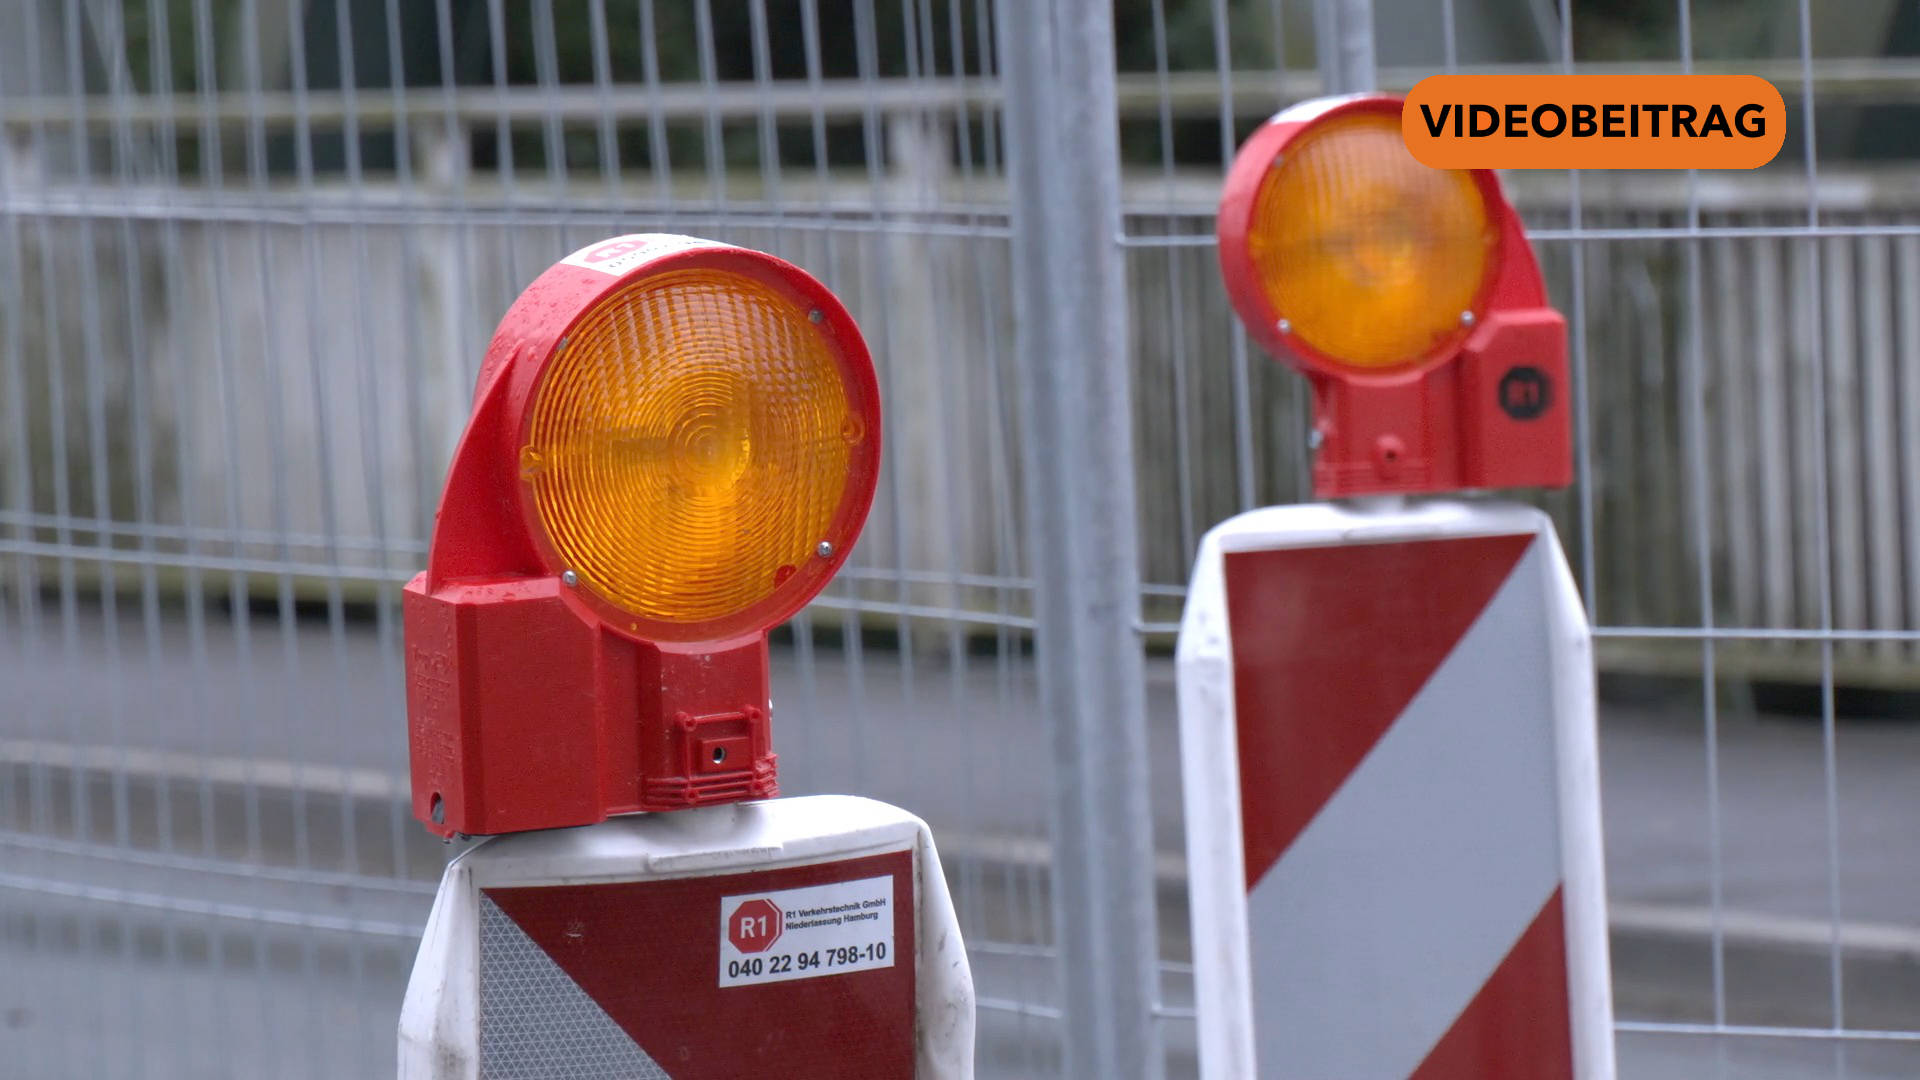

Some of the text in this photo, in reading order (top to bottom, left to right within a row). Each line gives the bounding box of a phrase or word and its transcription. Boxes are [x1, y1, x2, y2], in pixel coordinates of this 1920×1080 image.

[785, 898, 887, 919] R1 Verkehrstechnik GmbH
[740, 916, 767, 939] R1
[785, 911, 879, 931] Niederlassung Hamburg
[728, 942, 887, 978] 040 22 94 798-10
